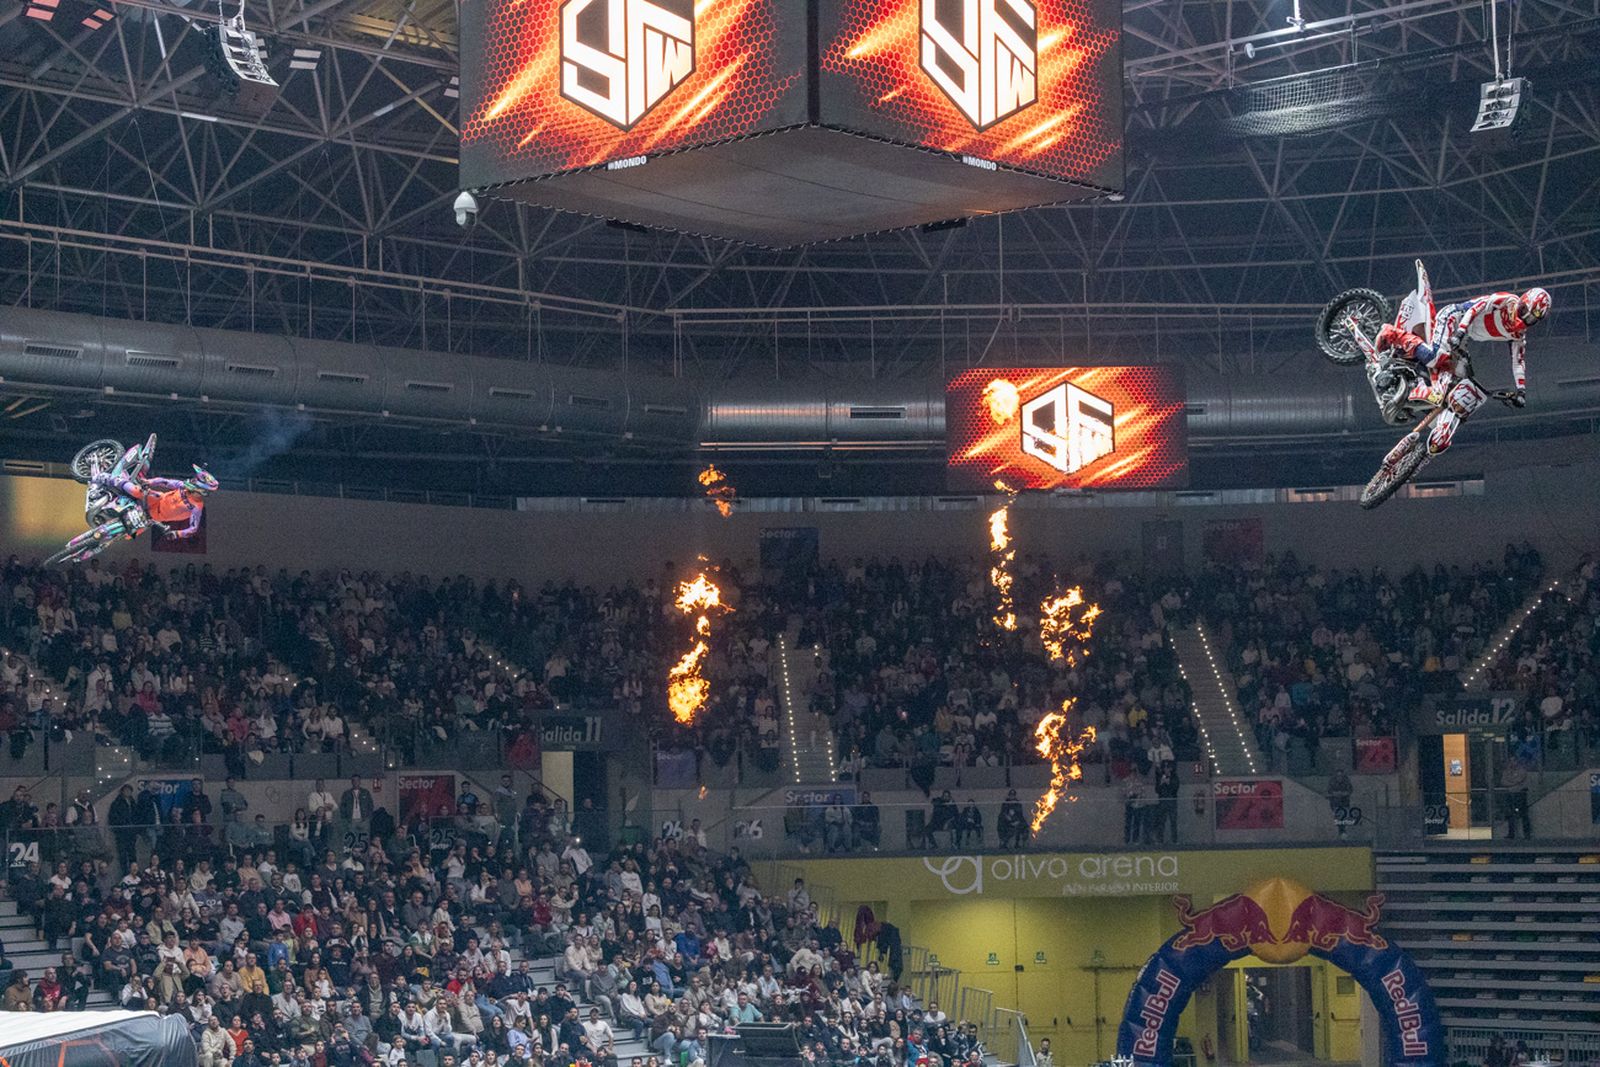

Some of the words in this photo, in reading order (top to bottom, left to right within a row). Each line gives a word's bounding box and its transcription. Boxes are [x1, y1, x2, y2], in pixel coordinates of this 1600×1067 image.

[614, 156, 647, 169] MONDO
[968, 157, 997, 171] MONDO
[1436, 709, 1489, 724] Salida
[1490, 699, 1515, 724] 12
[584, 716, 602, 742] 11
[399, 777, 436, 789] Sector
[1214, 783, 1257, 794] Sector
[10, 842, 39, 864] 24
[991, 854, 1068, 880] olivo
[1079, 855, 1179, 878] arena
[1133, 881, 1179, 892] INTERIOR
